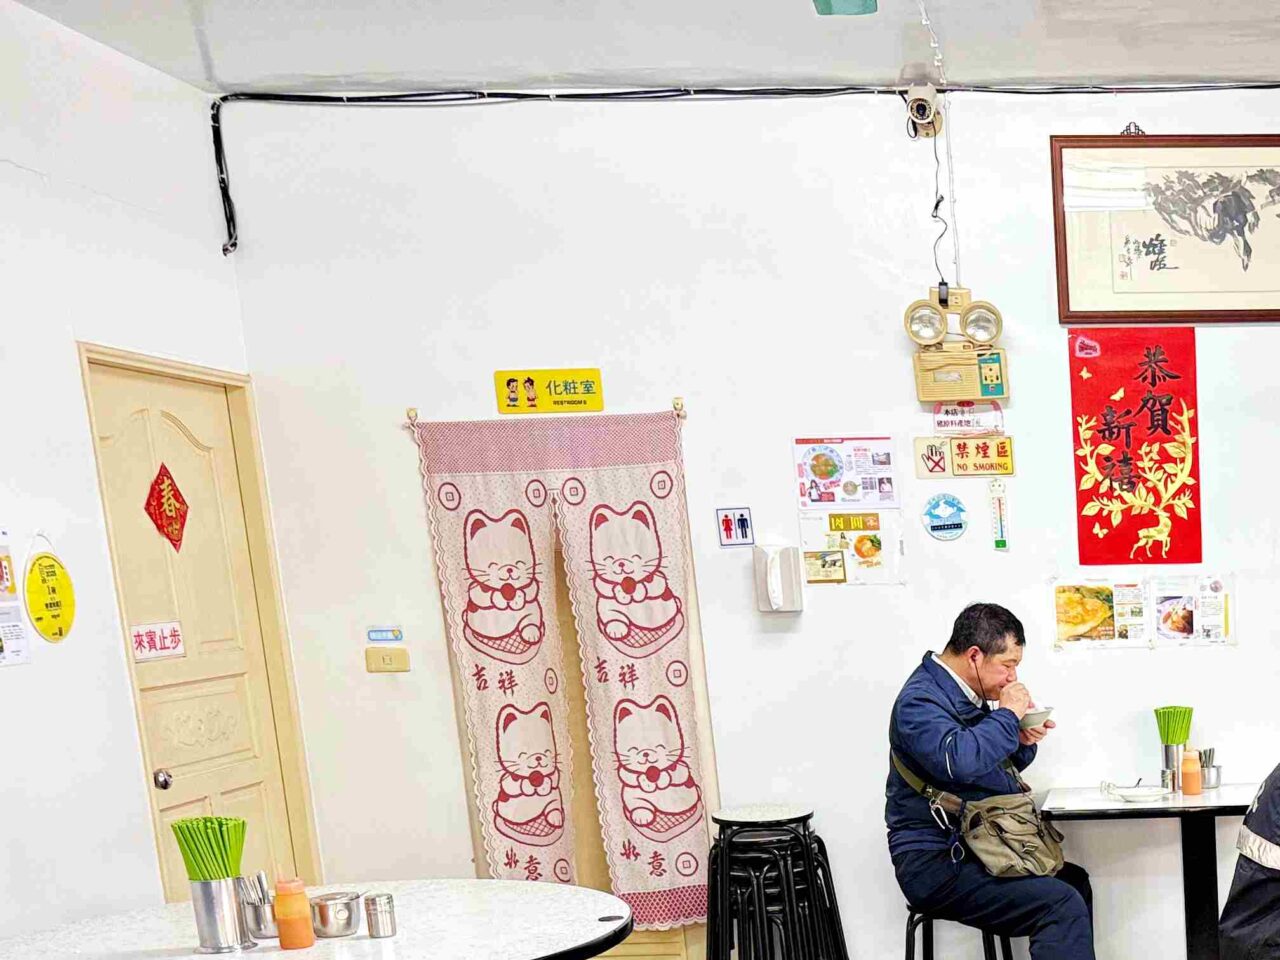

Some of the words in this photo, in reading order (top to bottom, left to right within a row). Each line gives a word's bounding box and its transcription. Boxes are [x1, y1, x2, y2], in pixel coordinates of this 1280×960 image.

[545, 379, 597, 396] 化粧室
[1133, 345, 1183, 437] 恭賀
[955, 441, 1009, 459] 禁煙區
[957, 463, 968, 471] NO
[974, 462, 1008, 471] SMOKING
[1097, 405, 1141, 493] 新禧
[160, 476, 180, 517] 春
[133, 628, 182, 653] 來賓止步
[472, 663, 519, 695] 吉祥
[594, 656, 639, 692] 吉祥
[504, 846, 543, 881] 如意
[620, 839, 667, 877] 如意
